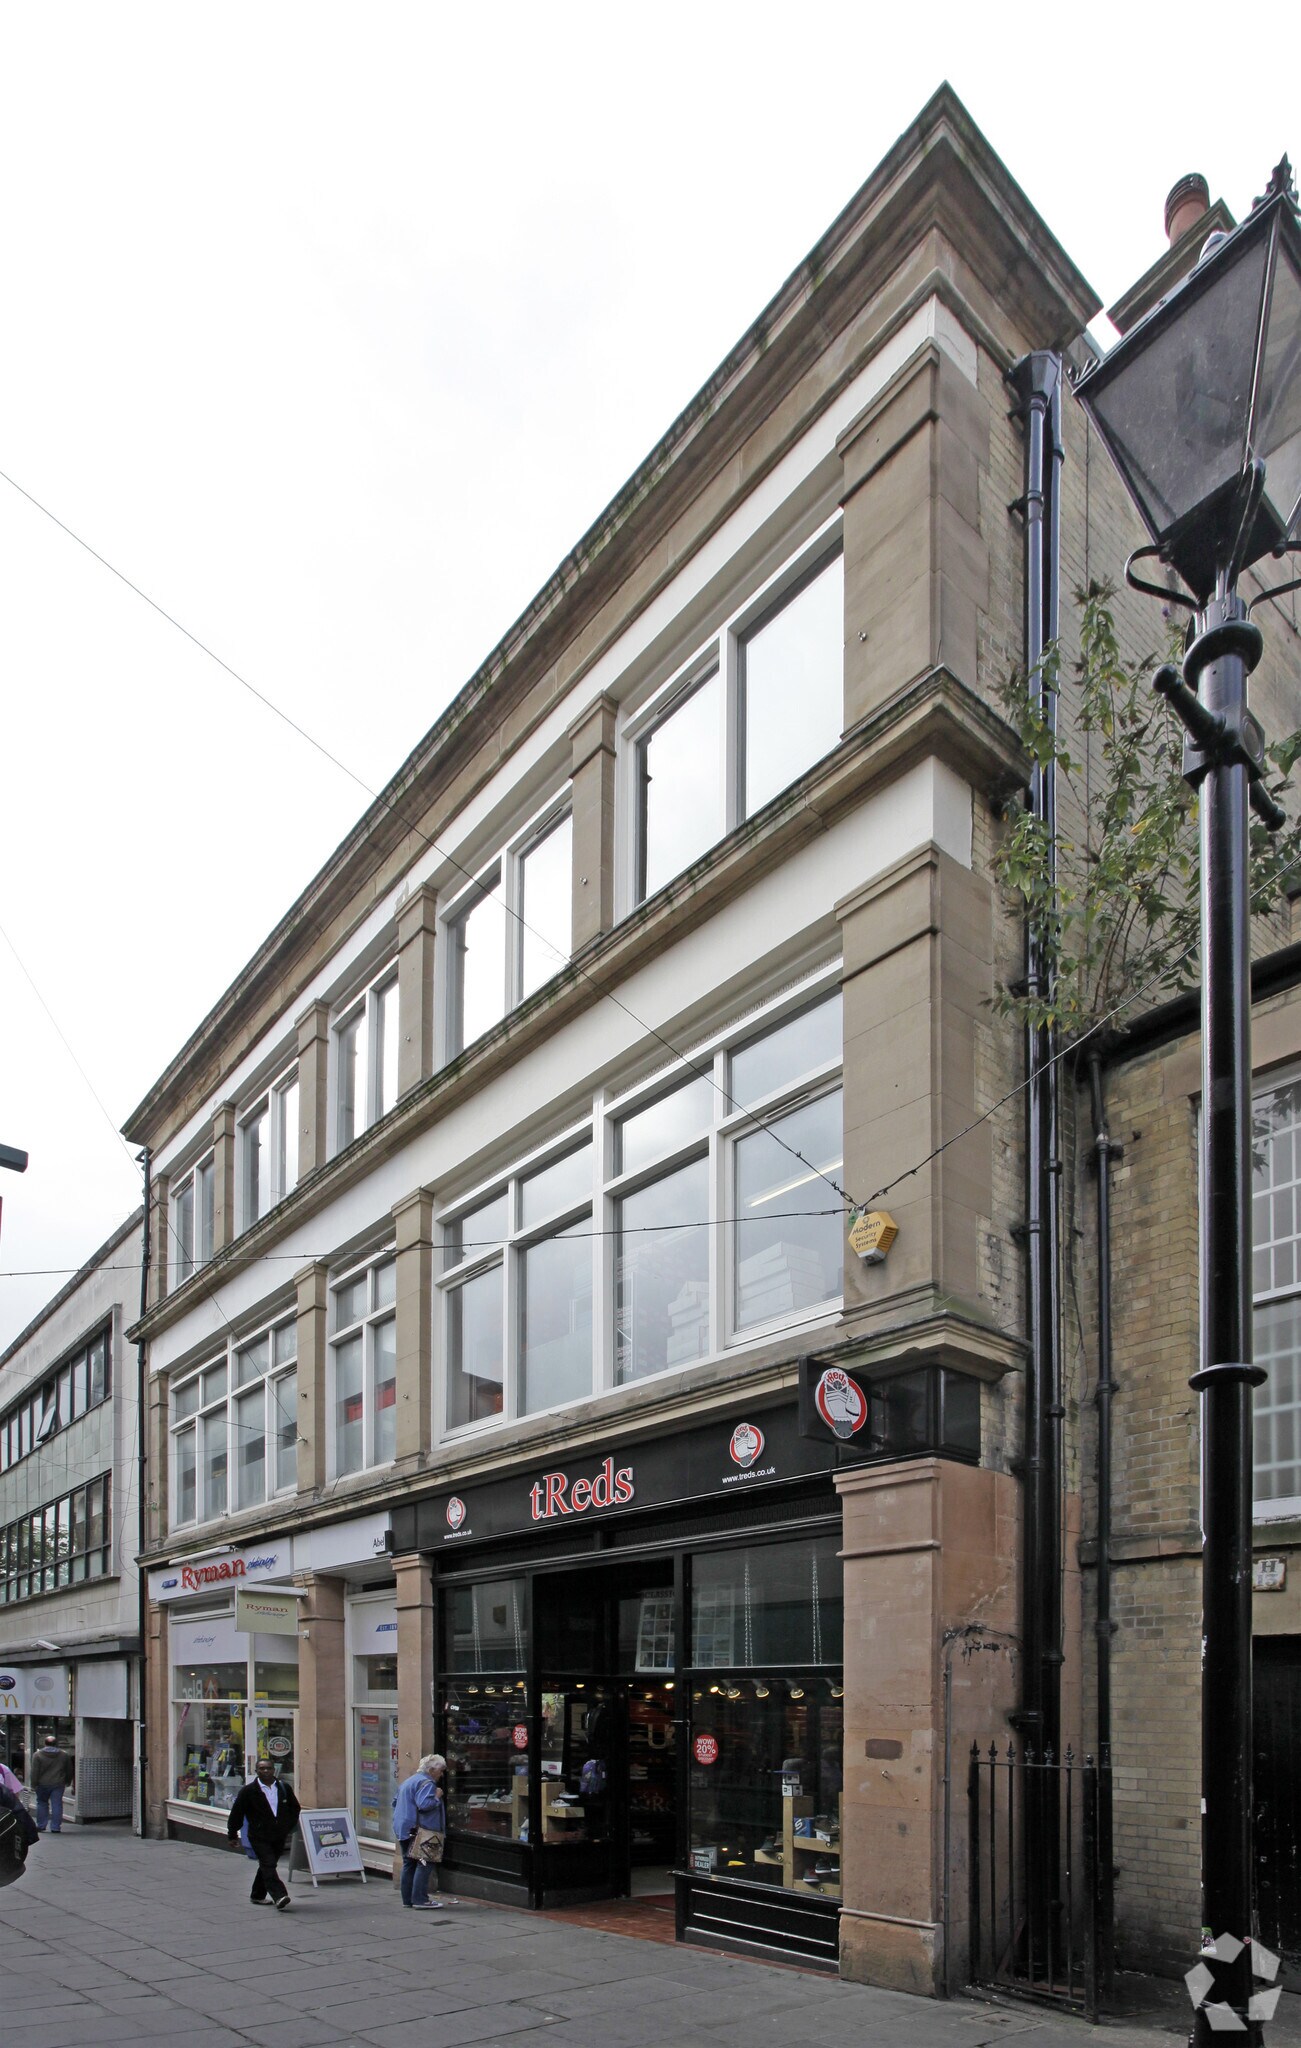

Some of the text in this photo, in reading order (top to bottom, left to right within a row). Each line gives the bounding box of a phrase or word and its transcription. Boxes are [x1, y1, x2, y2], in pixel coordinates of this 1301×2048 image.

[852, 1221, 881, 1235] Modern
[855, 1231, 877, 1242] Security
[855, 1238, 877, 1249] Systems
[721, 1466, 776, 1484] www.treds.co.uk
[529, 1456, 635, 1521] tReds
[181, 1558, 247, 1591] Ryman
[245, 1603, 289, 1613] Ryman
[696, 1744, 716, 1754] 20%
[324, 1848, 349, 1859] £69.99
